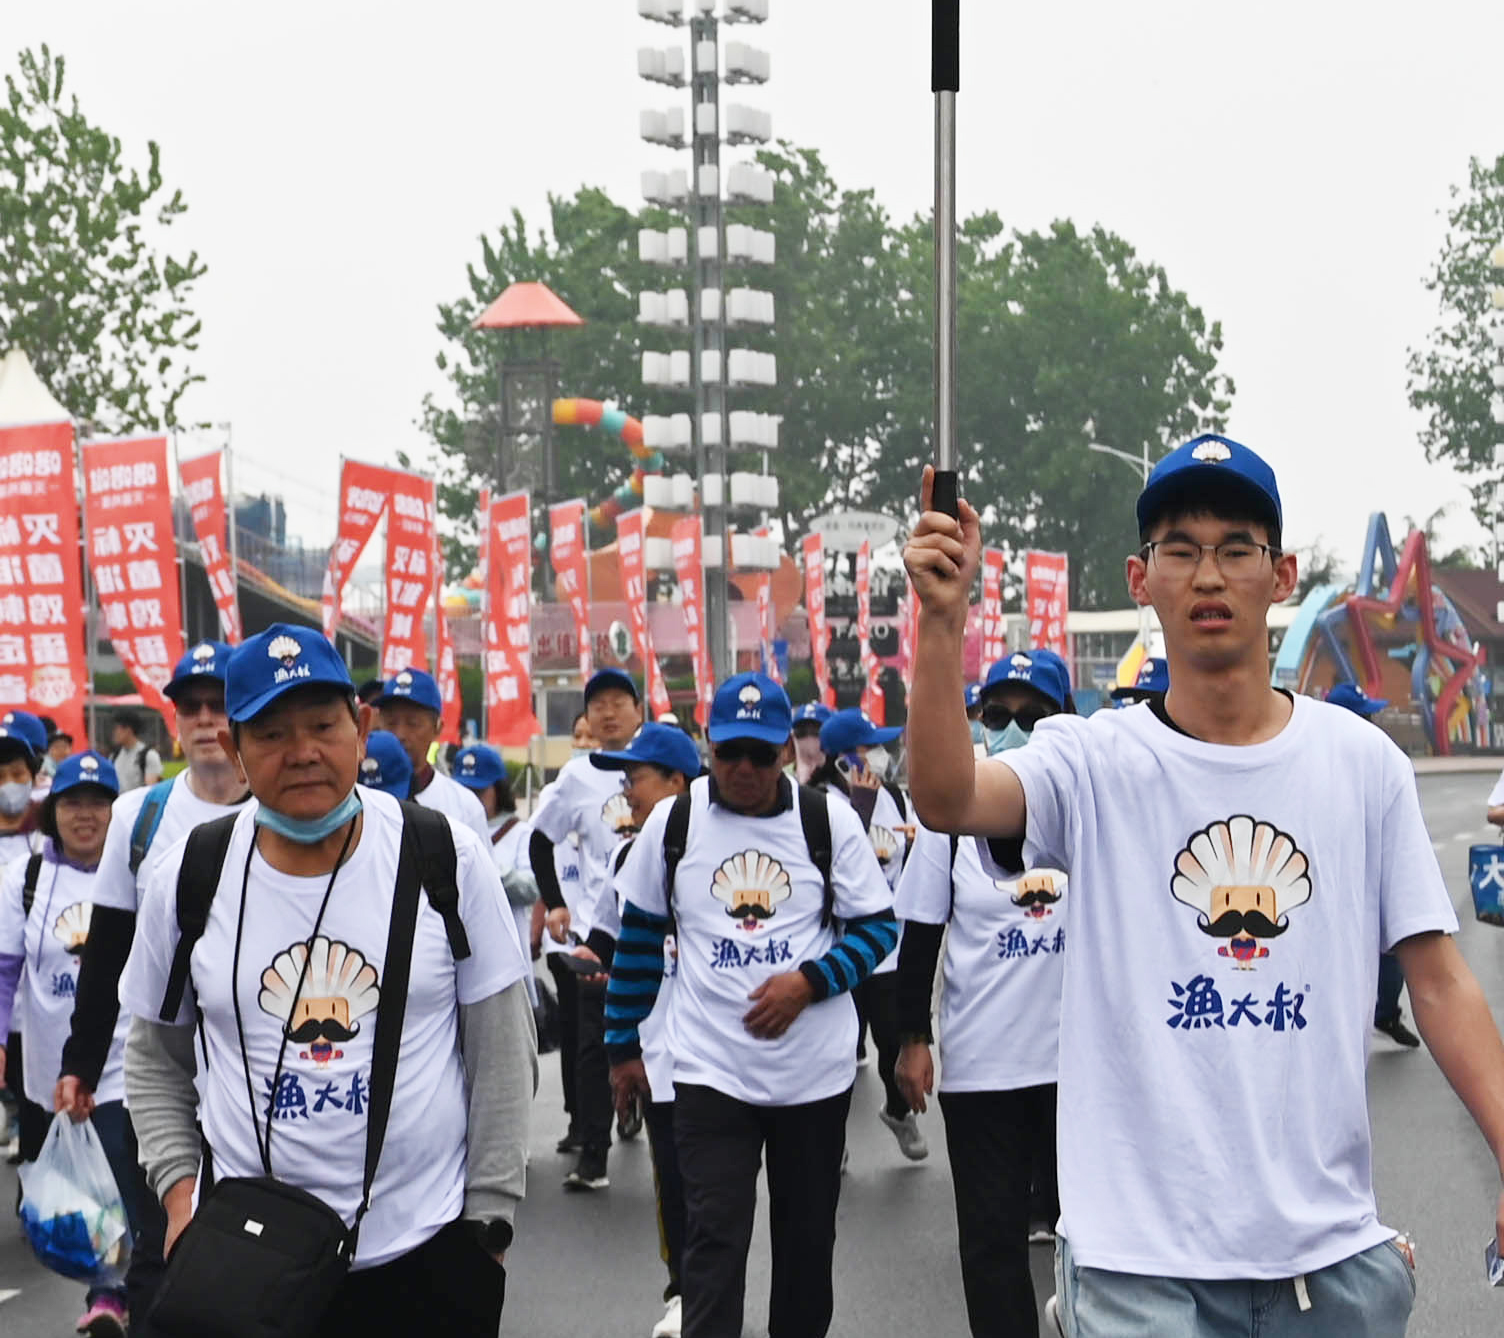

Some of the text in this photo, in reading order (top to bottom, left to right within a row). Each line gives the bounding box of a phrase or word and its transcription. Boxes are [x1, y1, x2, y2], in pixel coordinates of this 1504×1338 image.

[710, 935, 793, 969] 漁大叔
[1166, 974, 1307, 1033] 漁大叔
